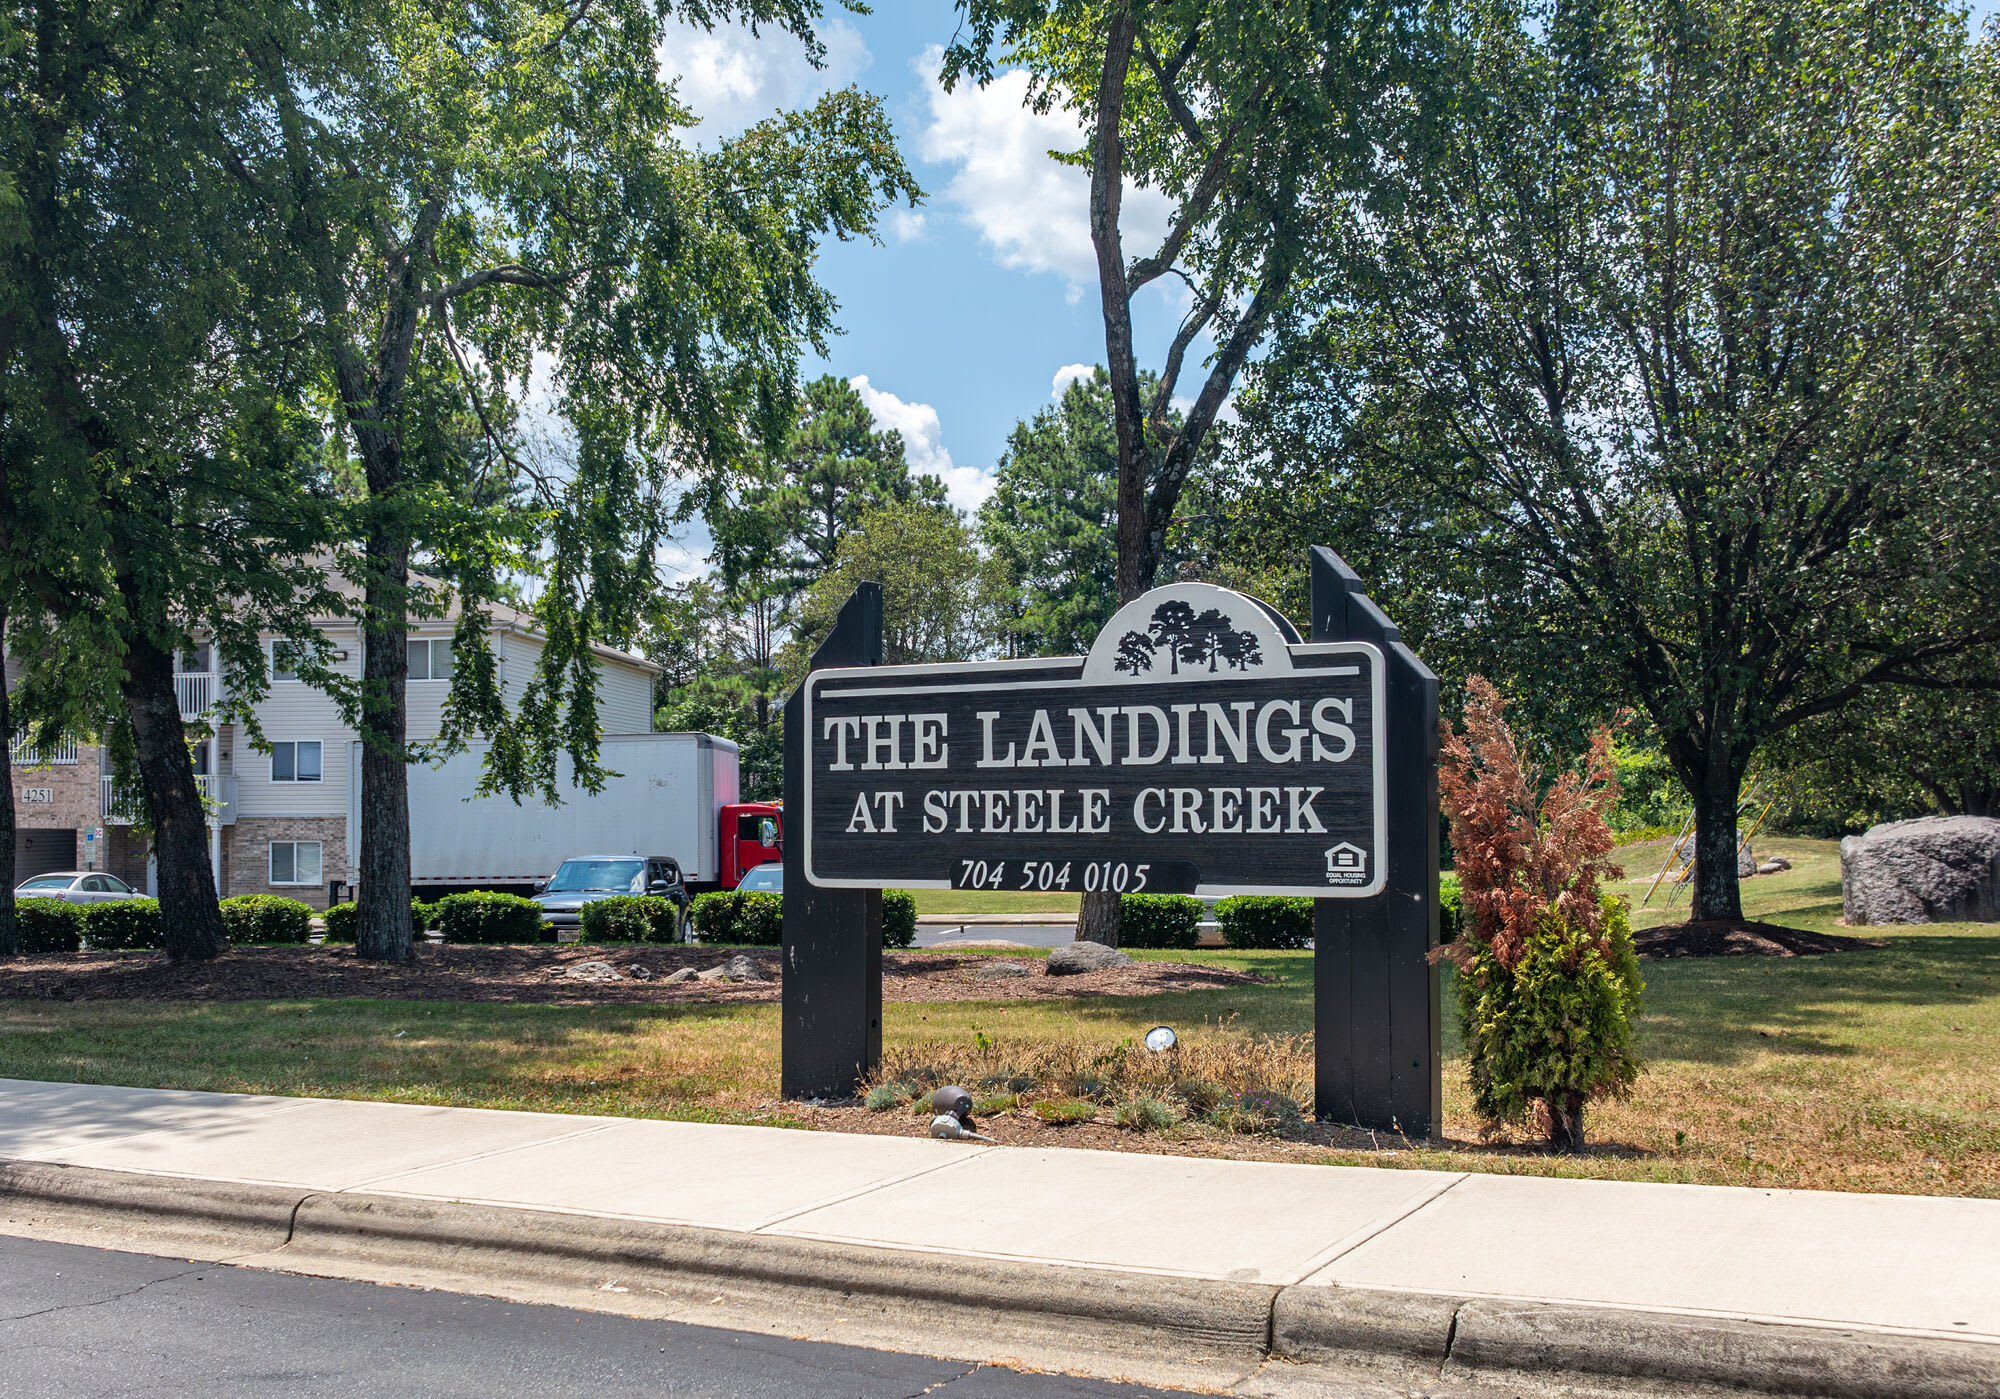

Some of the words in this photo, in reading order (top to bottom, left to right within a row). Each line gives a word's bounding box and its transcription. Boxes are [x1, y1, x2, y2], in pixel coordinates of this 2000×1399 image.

[823, 712, 949, 772] THE
[976, 697, 1357, 768] LANDINGS
[23, 789, 52, 802] 4251
[845, 791, 904, 833] AT
[922, 789, 1111, 833] STEELE
[1133, 786, 1329, 834] CREEK
[959, 859, 1006, 889] 704
[1019, 860, 1072, 891] 504
[1083, 861, 1151, 892] 0105
